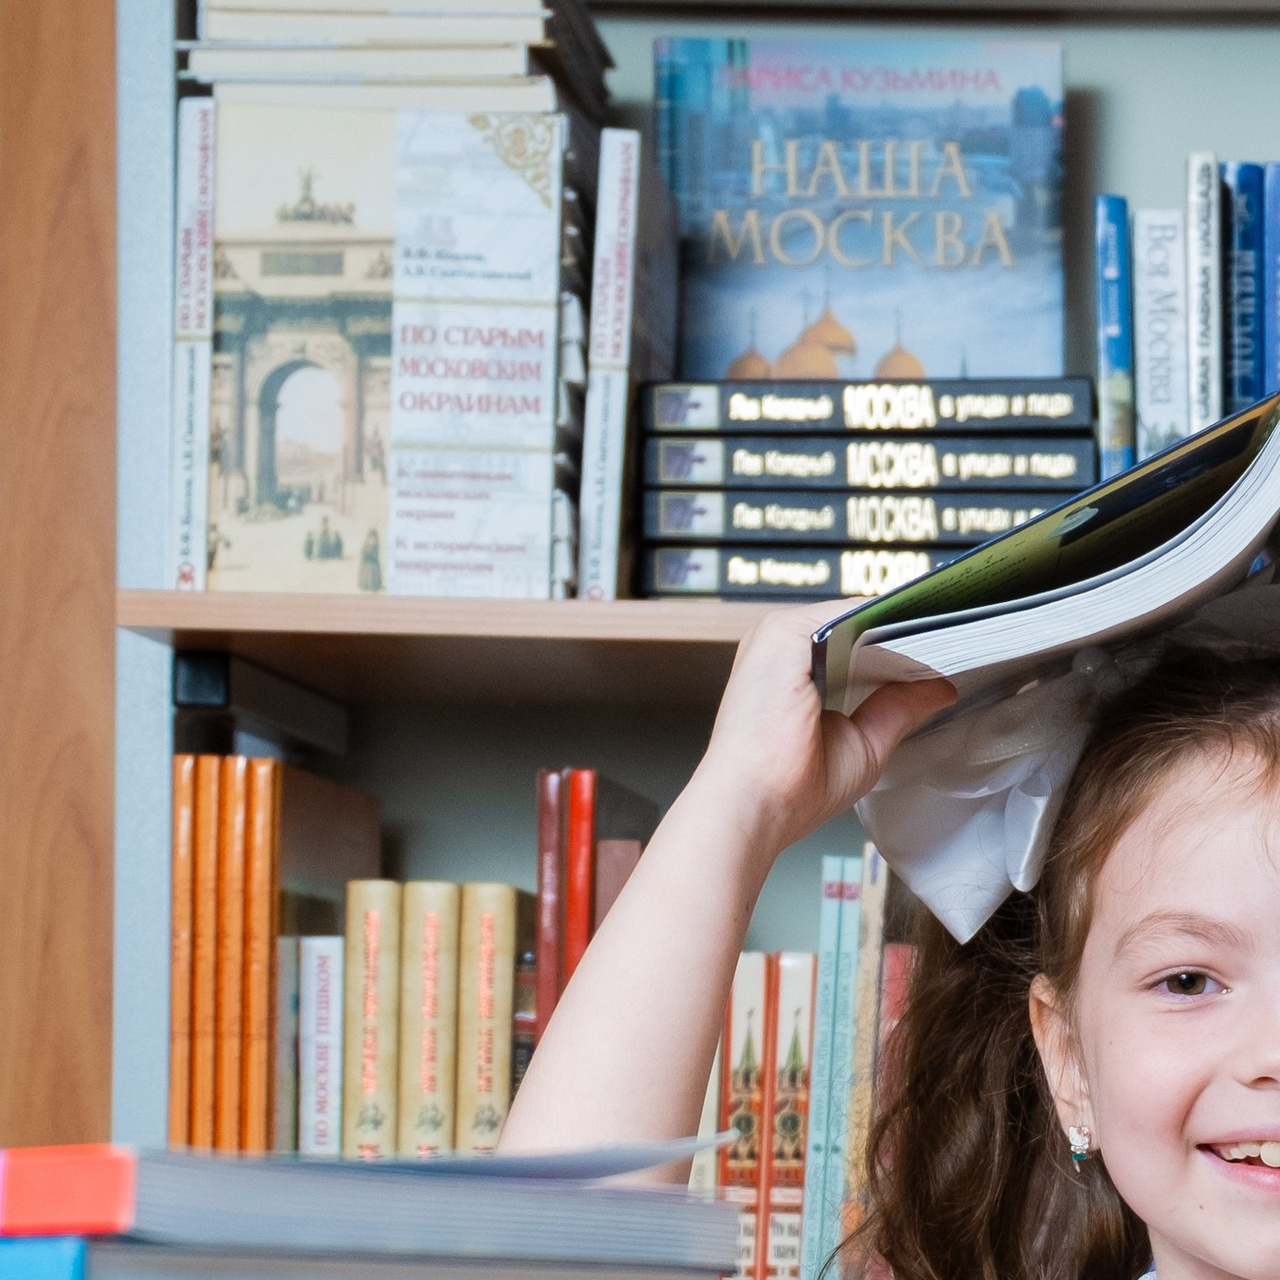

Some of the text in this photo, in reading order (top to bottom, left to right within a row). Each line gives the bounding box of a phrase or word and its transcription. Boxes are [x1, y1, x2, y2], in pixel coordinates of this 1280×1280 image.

[841, 68, 999, 92] КУЗЬМИНА
[750, 140, 972, 198] НАША
[706, 209, 1015, 267] МОСКВА
[400, 325, 545, 348] ПО СТАРЫМ
[1147, 223, 1178, 405] Вся Москва
[399, 357, 542, 381] МОСКОВСКИМ
[399, 391, 541, 415] ОКРАИНАМ
[842, 384, 936, 429] МОСКВА
[846, 443, 938, 487] МОСКВА
[847, 496, 938, 542] МОСКВА
[314, 954, 330, 1146] ПО МОСКВЕ ПЕШКОМ
